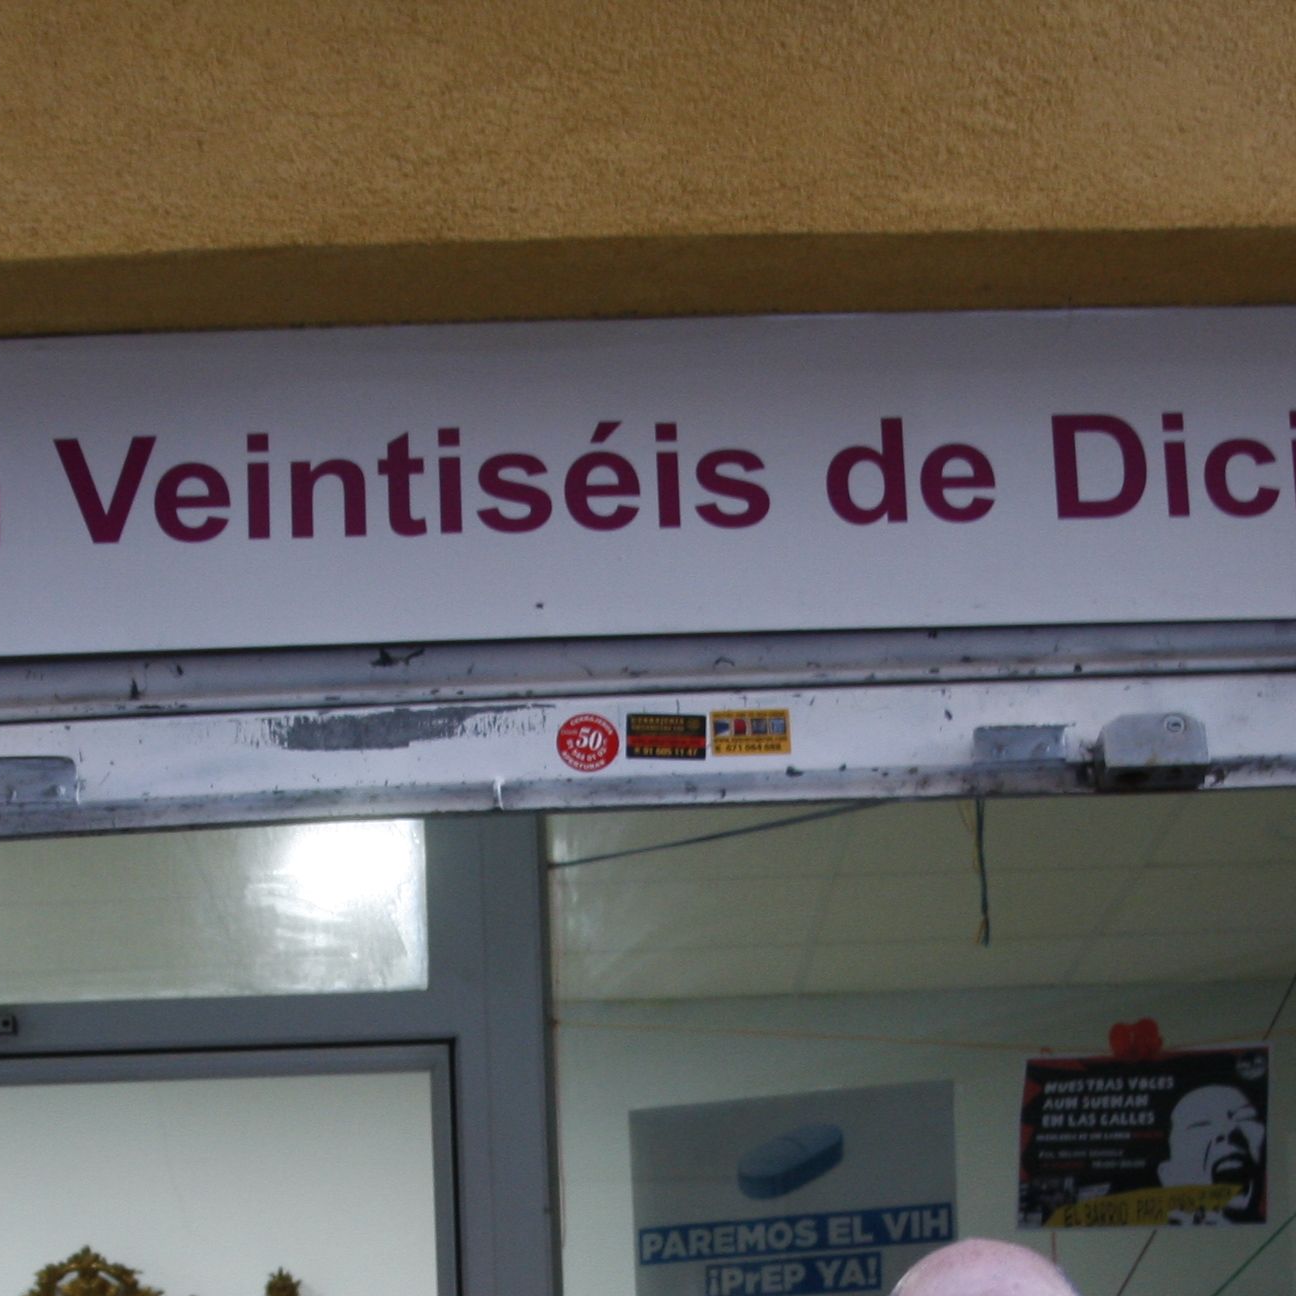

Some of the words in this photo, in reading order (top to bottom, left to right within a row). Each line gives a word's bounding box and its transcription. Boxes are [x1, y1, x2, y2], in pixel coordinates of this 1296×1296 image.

[60, 424, 769, 542] Veintiséis
[828, 420, 993, 522] de
[575, 727, 603, 752] 50
[1044, 1078, 1123, 1095] NUESTRAS
[1128, 1076, 1174, 1091] VOCES
[1082, 1094, 1149, 1110] SUENAN
[1041, 1114, 1064, 1127] EN
[1067, 1113, 1096, 1127] LAS
[1099, 1110, 1155, 1127] CALLES
[641, 1217, 818, 1261] PAREMOS
[828, 1216, 874, 1245] EL
[881, 1207, 949, 1240] VIH
[815, 1256, 877, 1289] YA!
